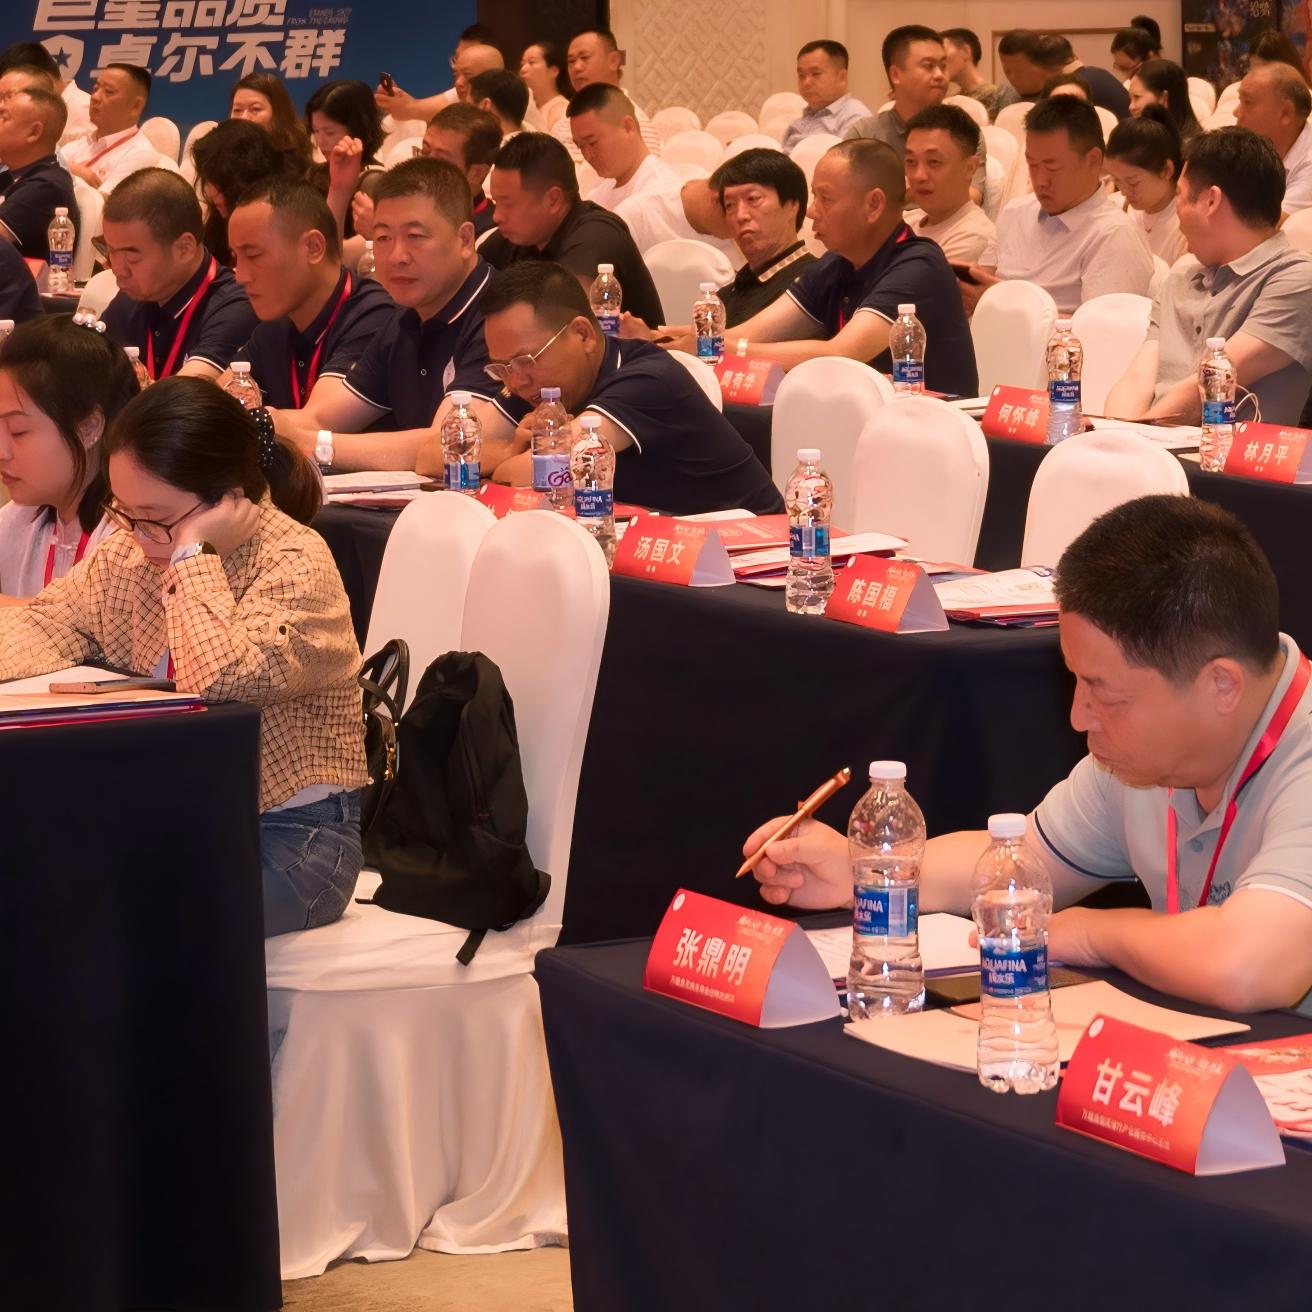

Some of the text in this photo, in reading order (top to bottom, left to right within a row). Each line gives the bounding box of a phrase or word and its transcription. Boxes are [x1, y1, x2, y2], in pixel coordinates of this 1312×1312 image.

[90, 29, 346, 82] 卓尔不群
[1243, 440, 1290, 467] 林月平
[634, 535, 686, 565] 汤国文
[846, 578, 899, 611] 陈国福
[672, 927, 752, 986] 张鼎明
[1091, 1058, 1184, 1128] 甘云峰
